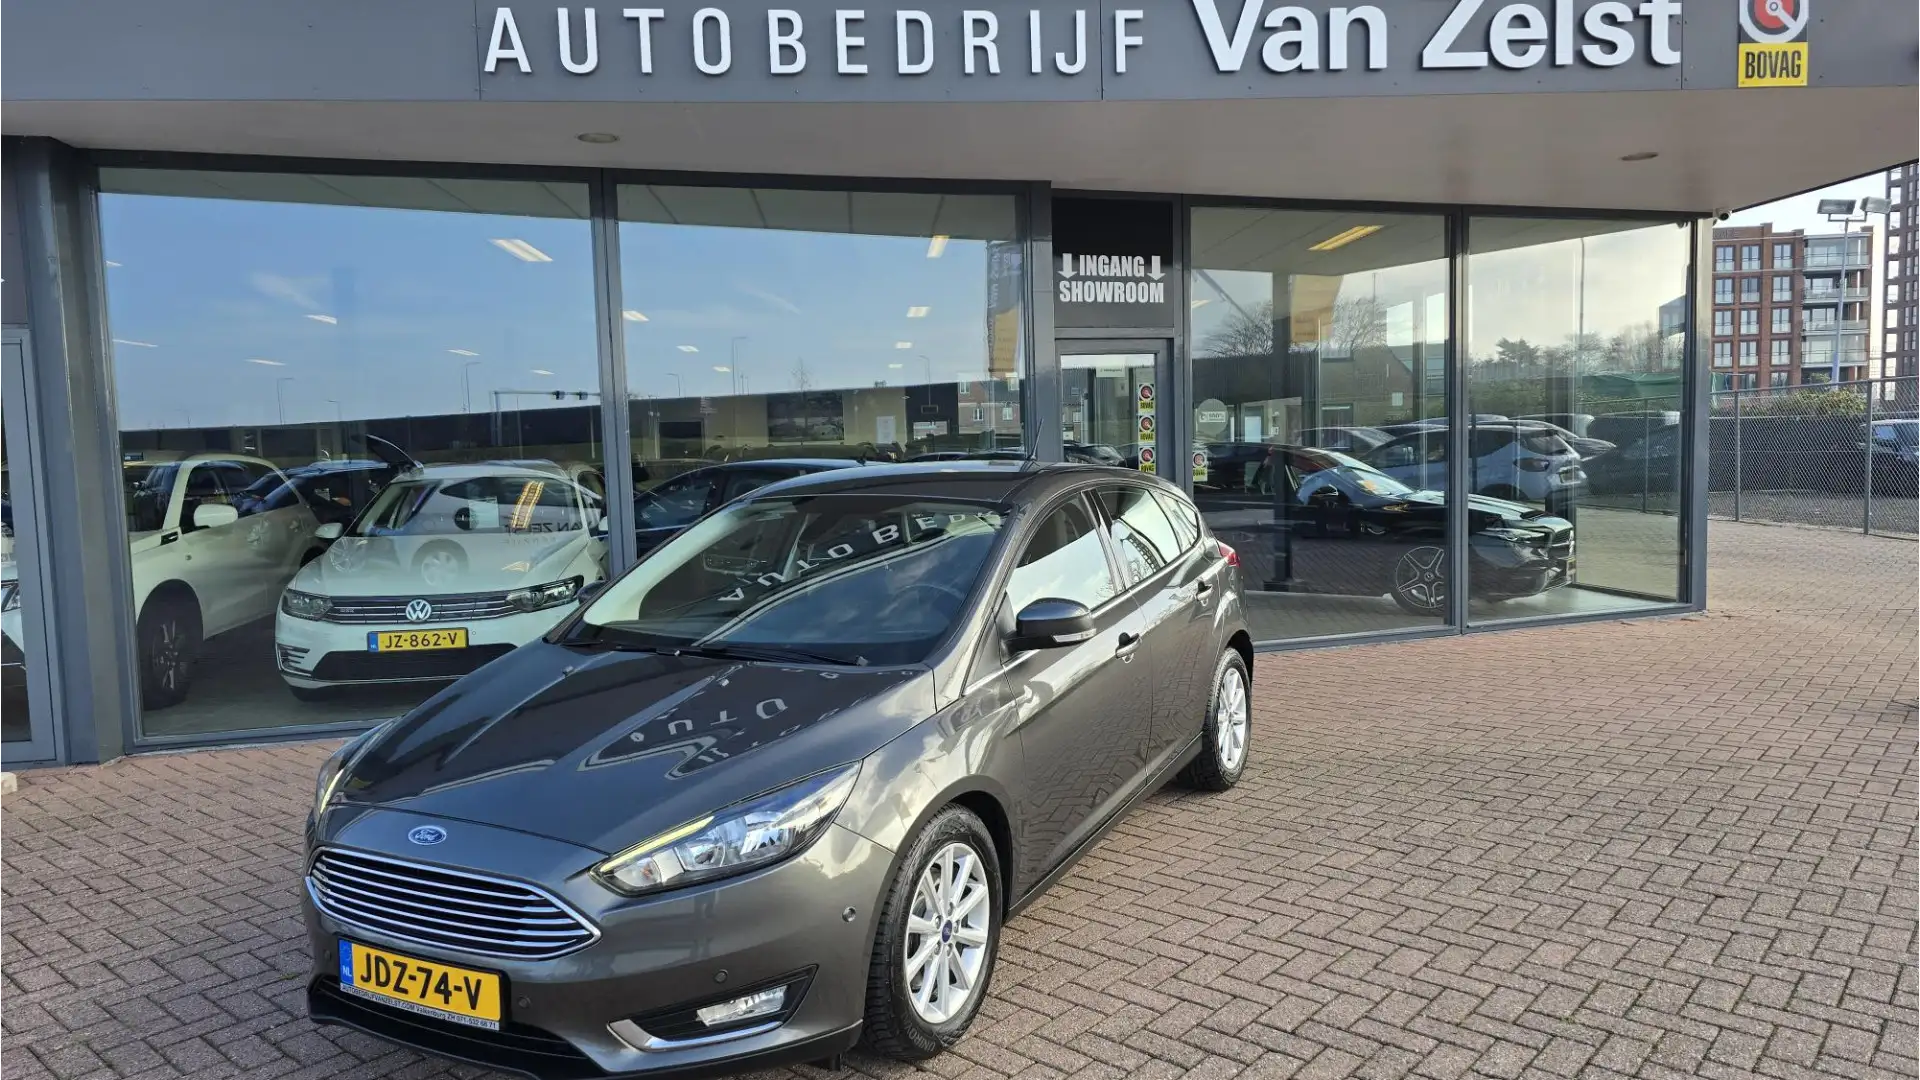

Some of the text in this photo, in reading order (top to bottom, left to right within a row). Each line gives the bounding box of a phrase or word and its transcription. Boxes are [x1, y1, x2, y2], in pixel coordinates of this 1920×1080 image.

[484, 7, 1144, 76] AUTOBEDRIJF
[1195, 0, 1681, 72] Van Zelst
[1744, 49, 1803, 81] BOVAG
[1079, 254, 1145, 278] INGANG
[1059, 280, 1165, 304] SHOWROOM
[385, 631, 458, 649] JZ-862-V
[342, 965, 353, 977] NL
[360, 952, 482, 1011] JDZ-74-V
